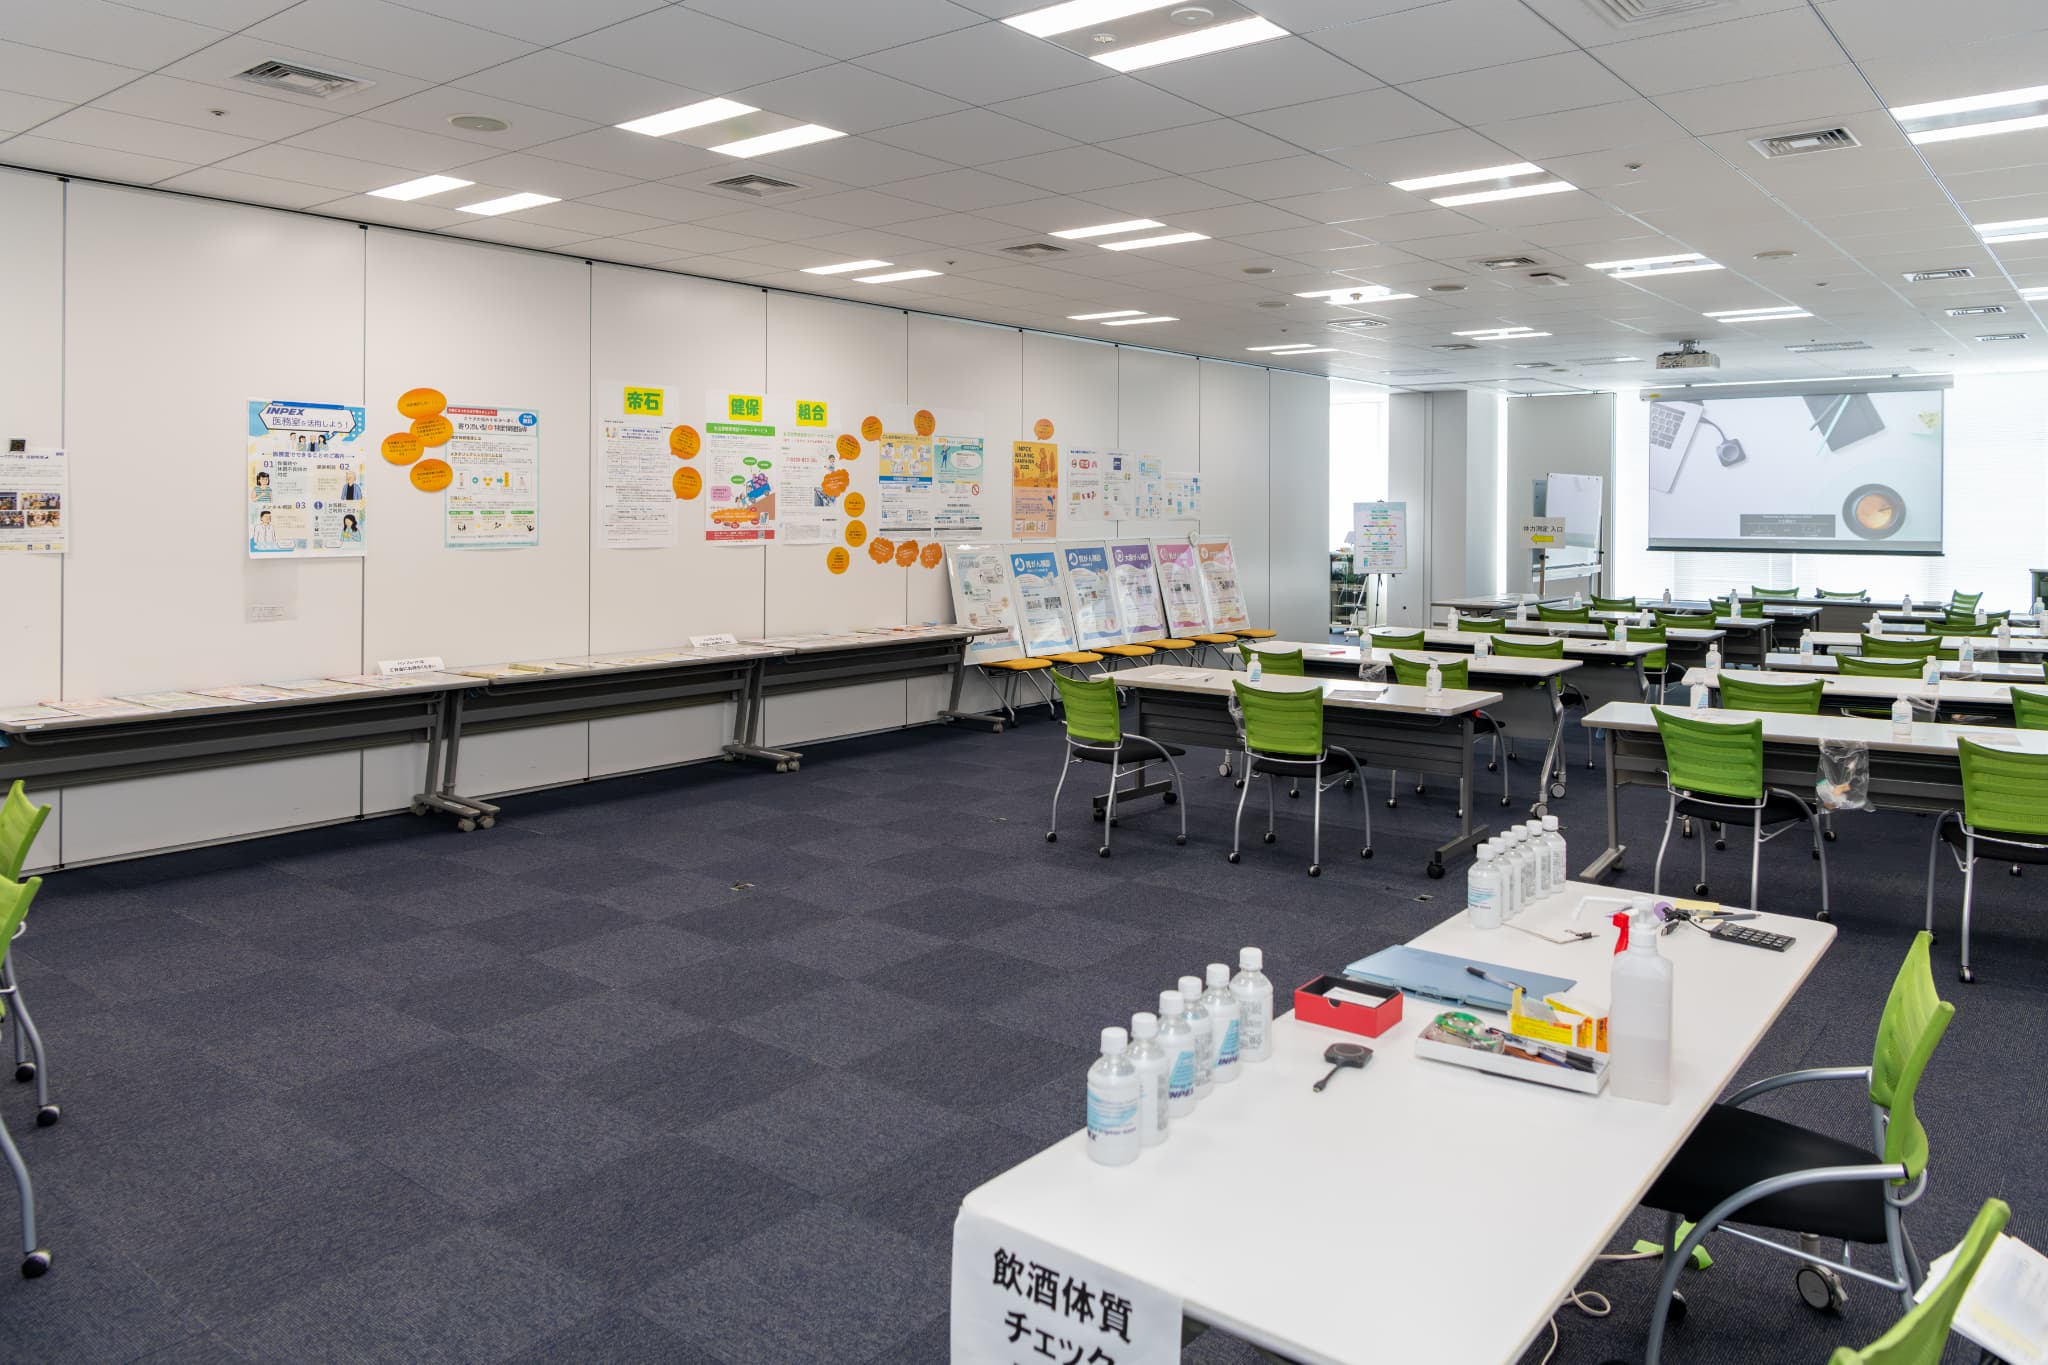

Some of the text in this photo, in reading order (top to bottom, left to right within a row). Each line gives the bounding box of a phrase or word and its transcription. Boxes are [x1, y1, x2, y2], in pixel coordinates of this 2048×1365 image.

[627, 391, 660, 411] 帝石
[731, 398, 759, 417] 健保
[266, 407, 304, 416] INPEX
[798, 403, 825, 421] 組合
[295, 501, 306, 509] 03
[1551, 525, 1563, 533] 入口
[1218, 1055, 1239, 1065] INPE
[992, 1247, 1133, 1344] 飲酒体質
